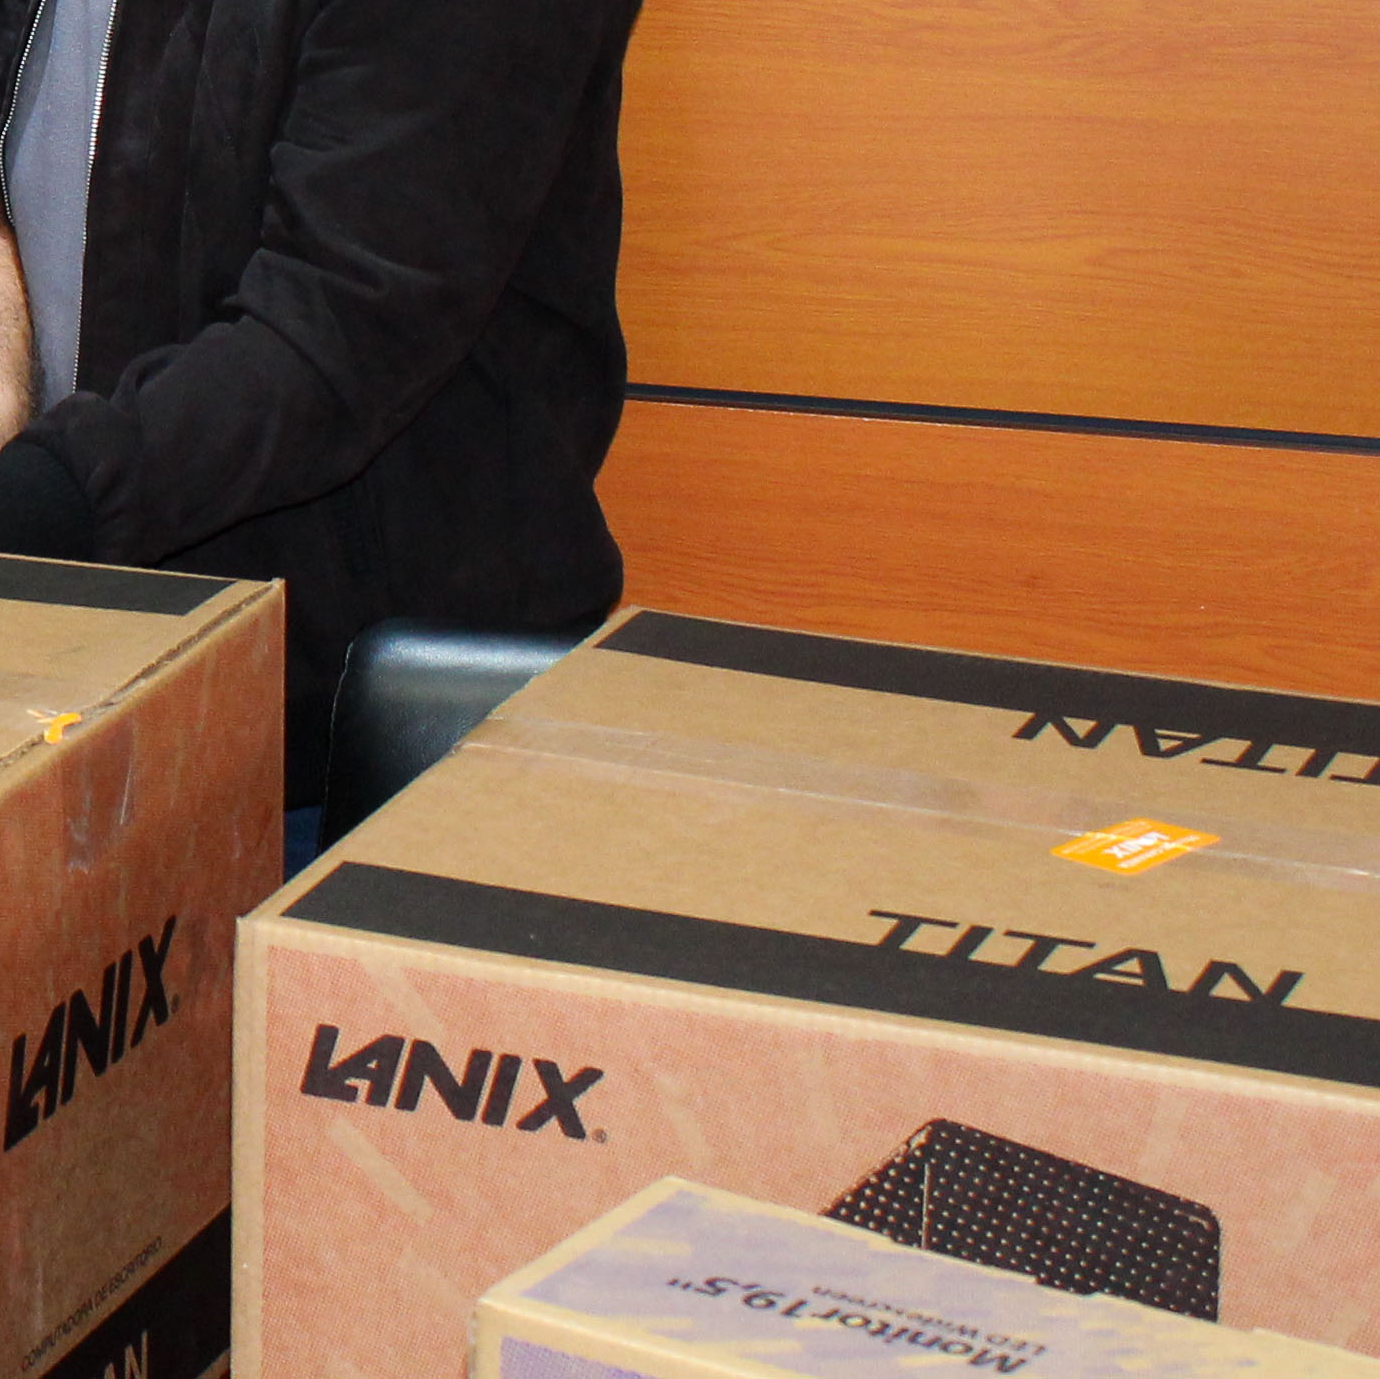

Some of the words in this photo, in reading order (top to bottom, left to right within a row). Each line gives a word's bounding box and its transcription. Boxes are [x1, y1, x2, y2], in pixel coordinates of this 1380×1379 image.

[865, 909, 1304, 1008] TITAN
[3, 915, 177, 1153] LANIX
[300, 1023, 604, 1141] LANIX
